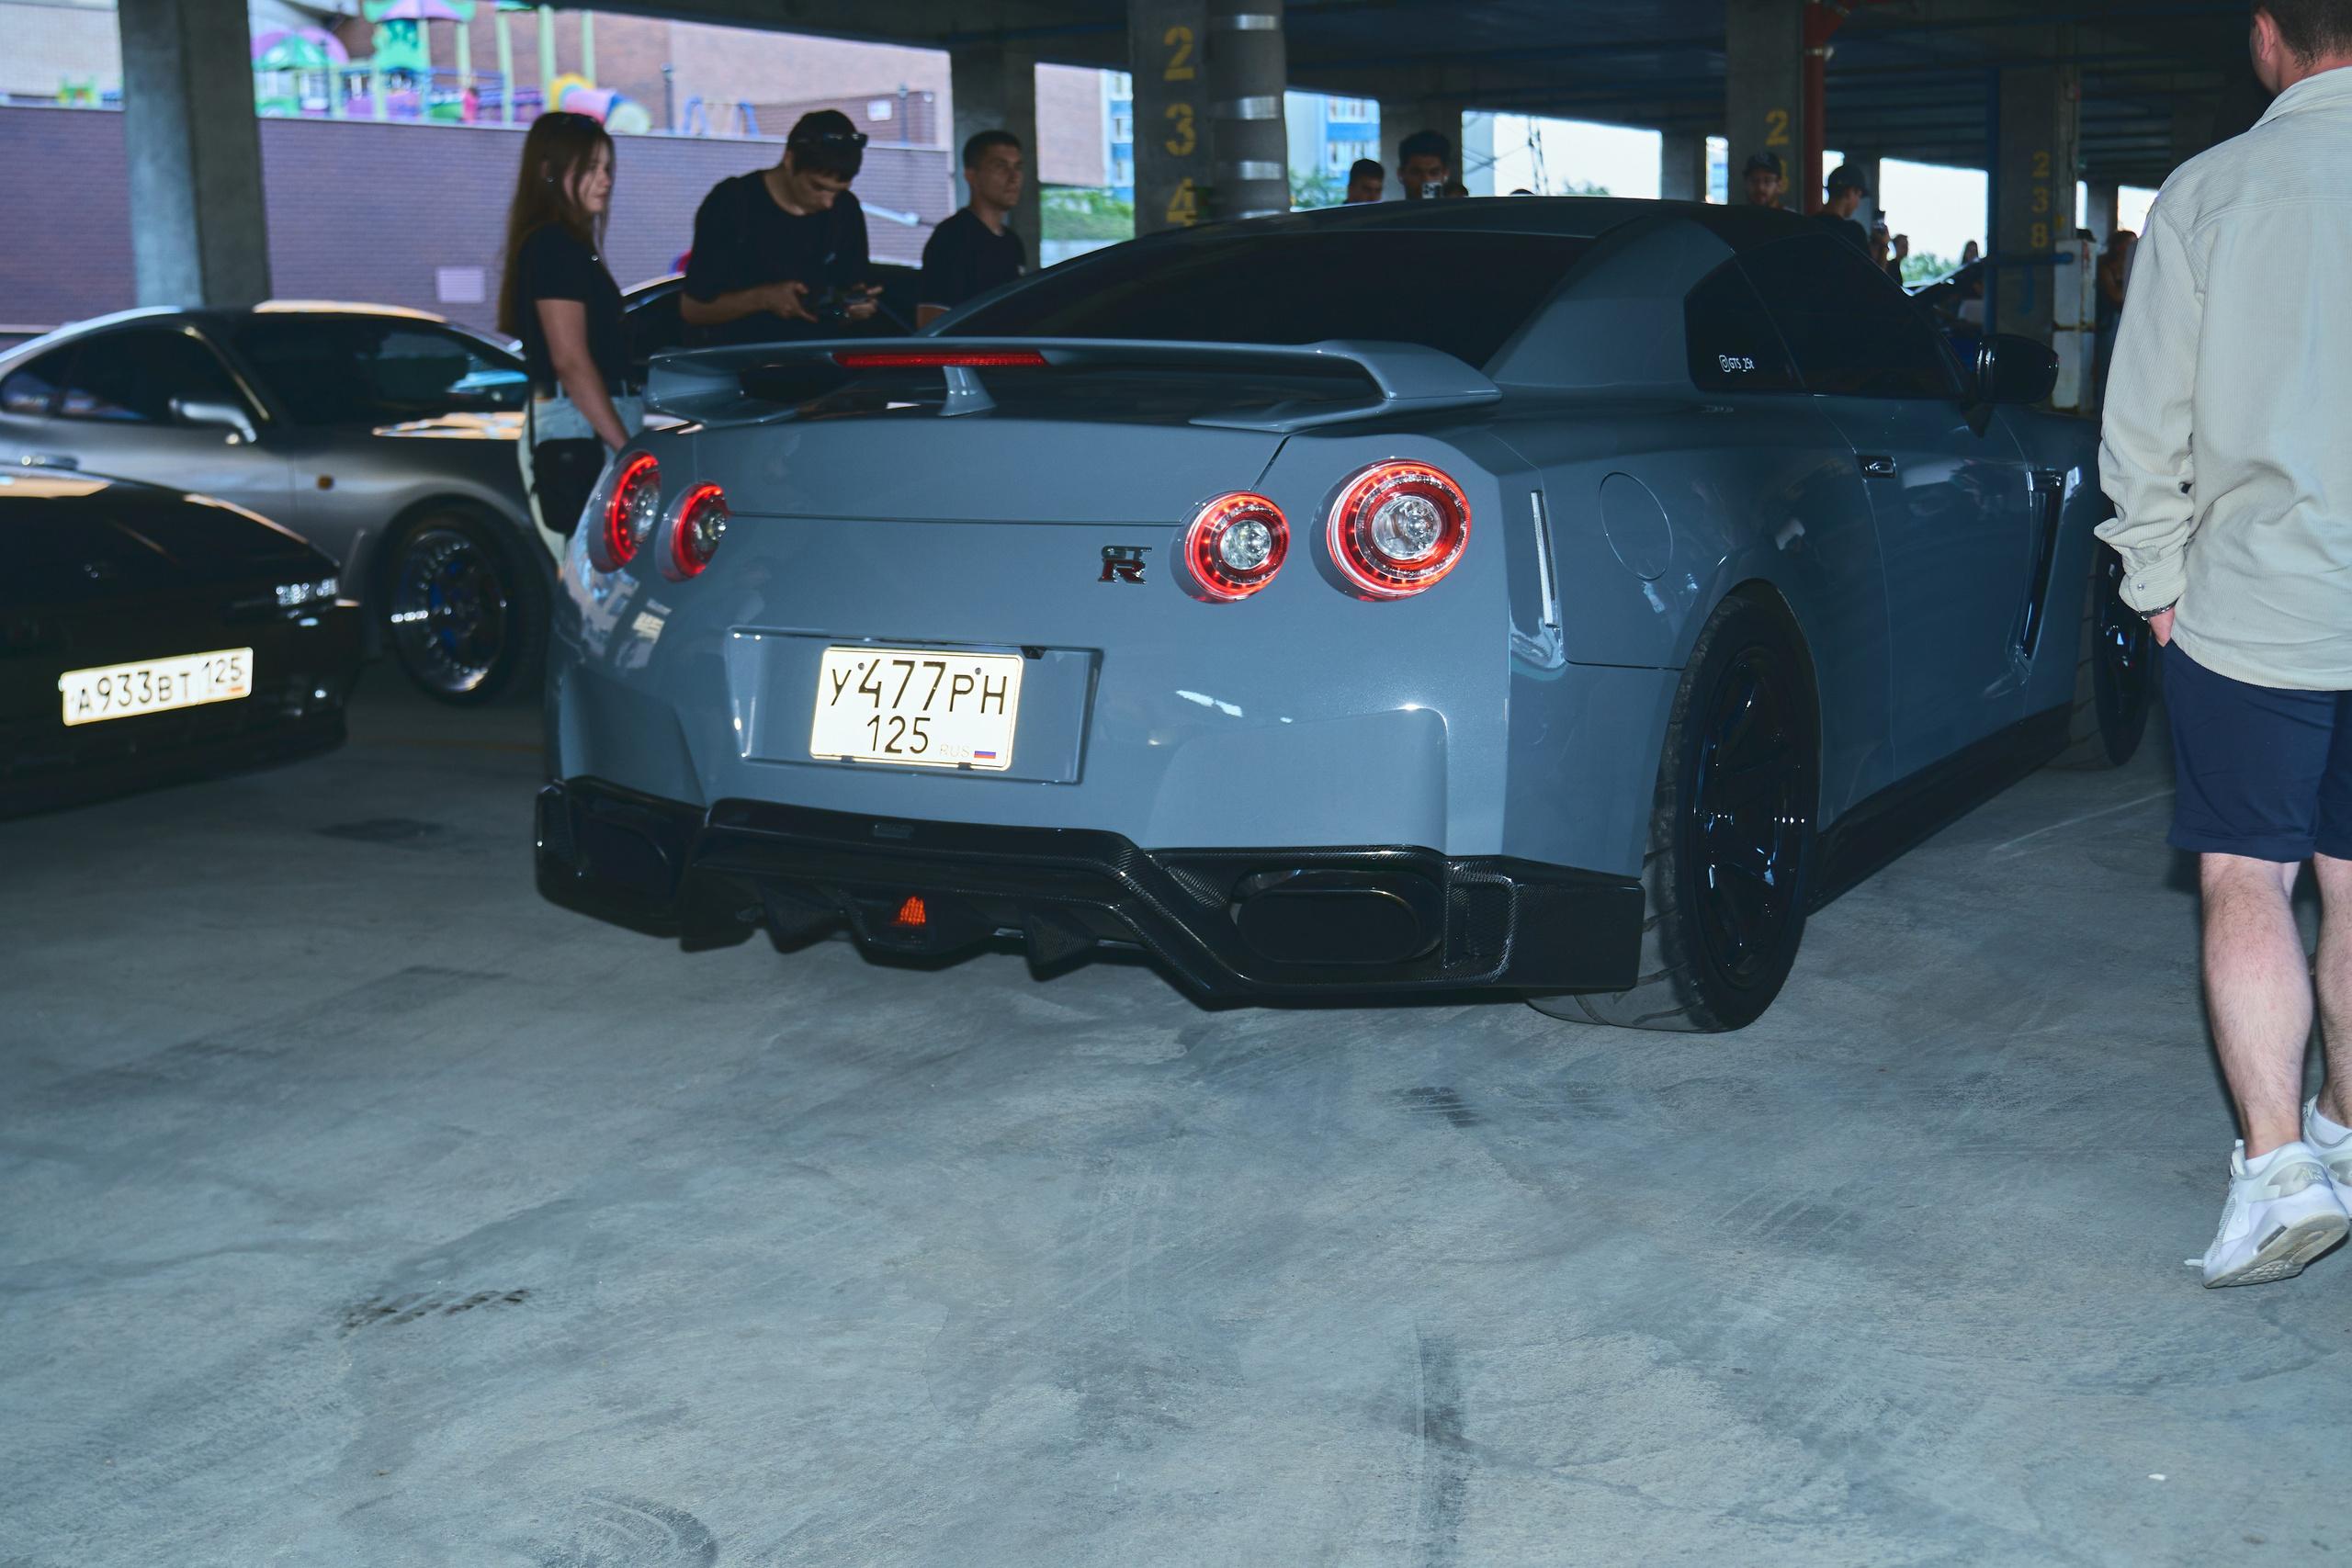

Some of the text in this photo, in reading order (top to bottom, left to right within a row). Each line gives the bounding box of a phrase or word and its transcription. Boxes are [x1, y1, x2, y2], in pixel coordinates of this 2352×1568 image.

[201, 655, 245, 689] 125
[866, 714, 970, 759] 125 RUS
